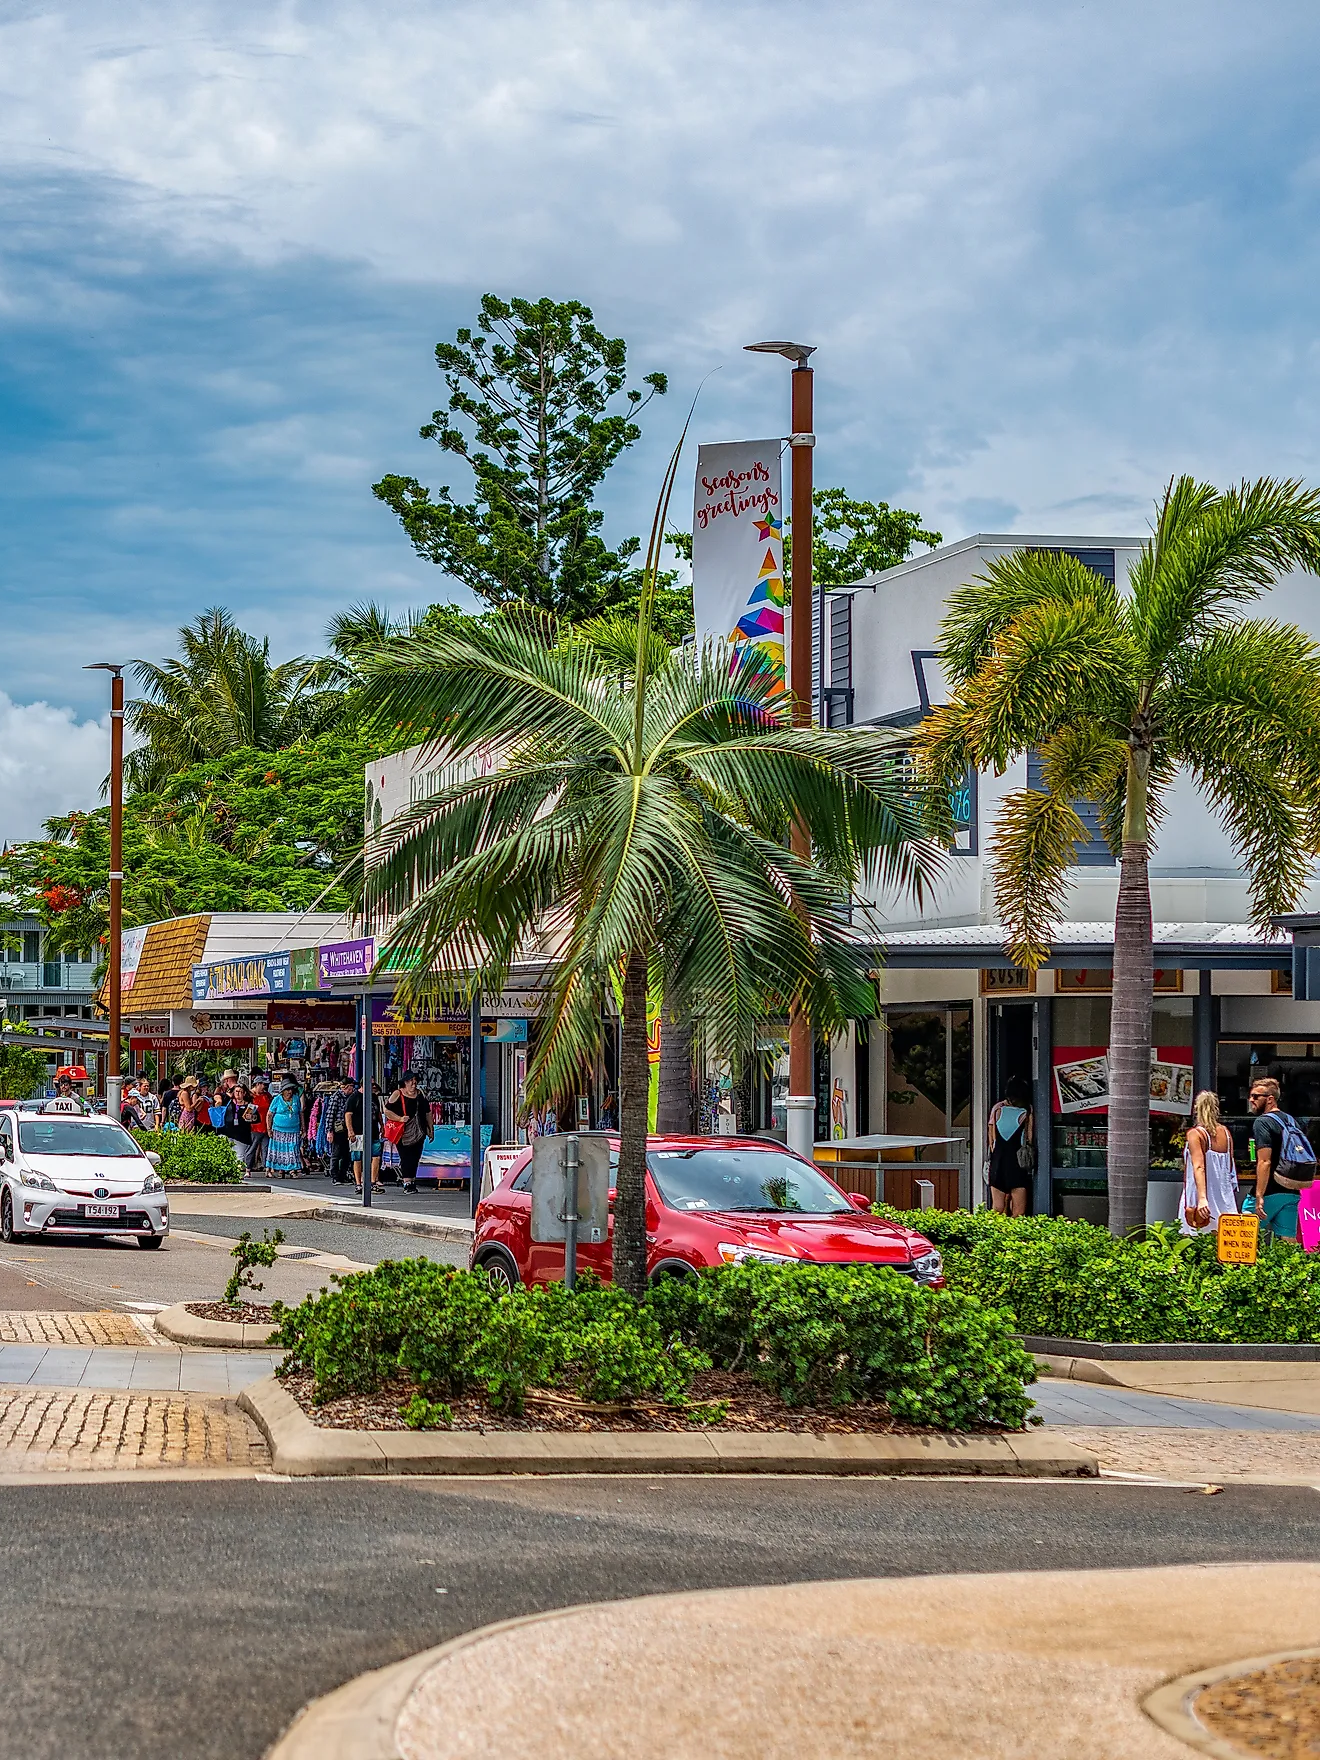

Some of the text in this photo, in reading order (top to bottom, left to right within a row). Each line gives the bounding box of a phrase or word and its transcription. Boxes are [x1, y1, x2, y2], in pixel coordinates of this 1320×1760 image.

[701, 461, 770, 497] season's
[697, 485, 779, 529] greetings
[133, 1024, 166, 1034] WHERE
[212, 1021, 257, 1030] TRADING
[151, 1037, 232, 1048] Whitsunday Travel
[54, 1102, 73, 1111] TAXI
[1221, 1218, 1257, 1227] PEDESTRIANS
[1240, 1230, 1254, 1238] CROSS
[1241, 1241, 1253, 1249] ROAD
